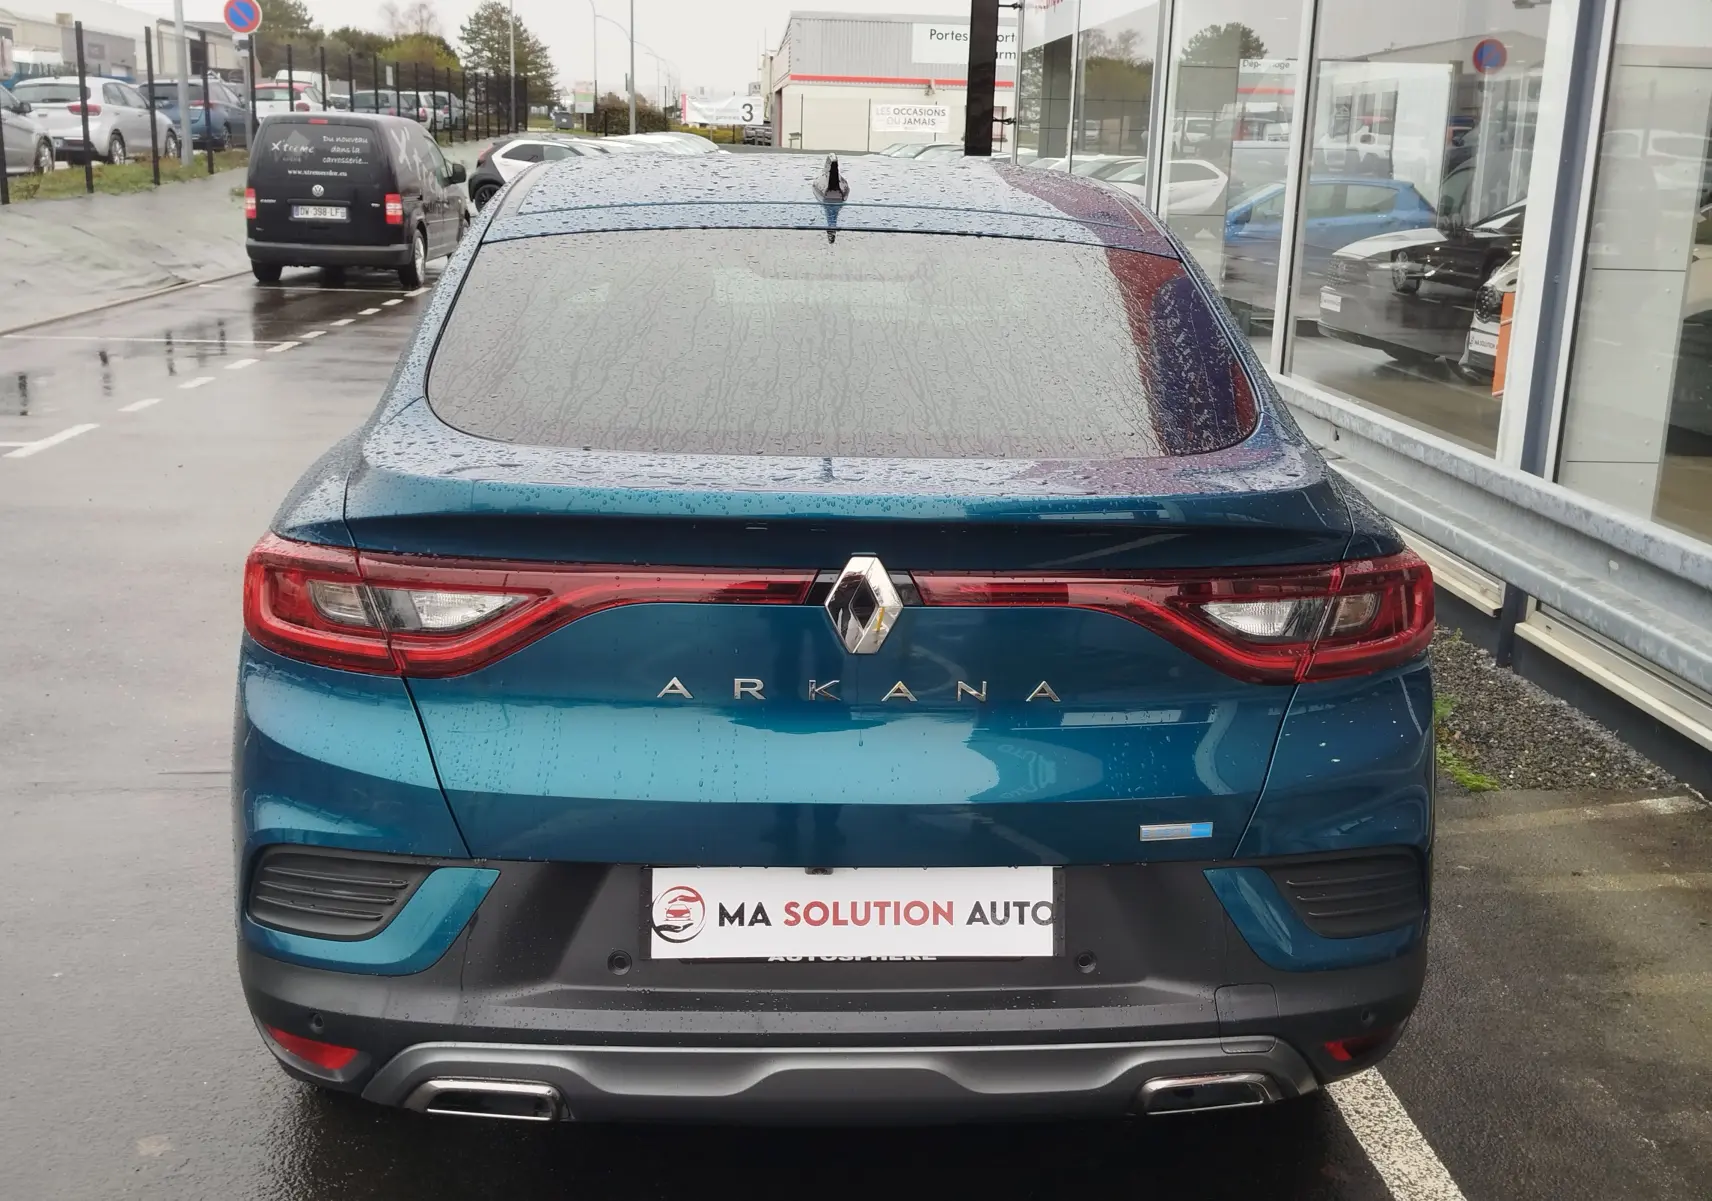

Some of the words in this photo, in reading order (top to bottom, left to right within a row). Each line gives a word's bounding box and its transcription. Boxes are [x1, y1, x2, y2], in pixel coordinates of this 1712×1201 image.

[929, 28, 968, 42] Portes
[741, 103, 754, 122] 3
[876, 106, 891, 116] LES
[893, 107, 946, 117] OCCASIONS
[886, 116, 901, 125] OU
[903, 117, 936, 126] JAMAIS
[336, 136, 368, 144] nouveau
[330, 145, 350, 153] dans
[352, 146, 361, 154] la
[656, 676, 1061, 702] ARKANA
[717, 901, 772, 927] MA
[783, 900, 954, 927] SOLUTION
[965, 900, 1053, 926] AUTO
